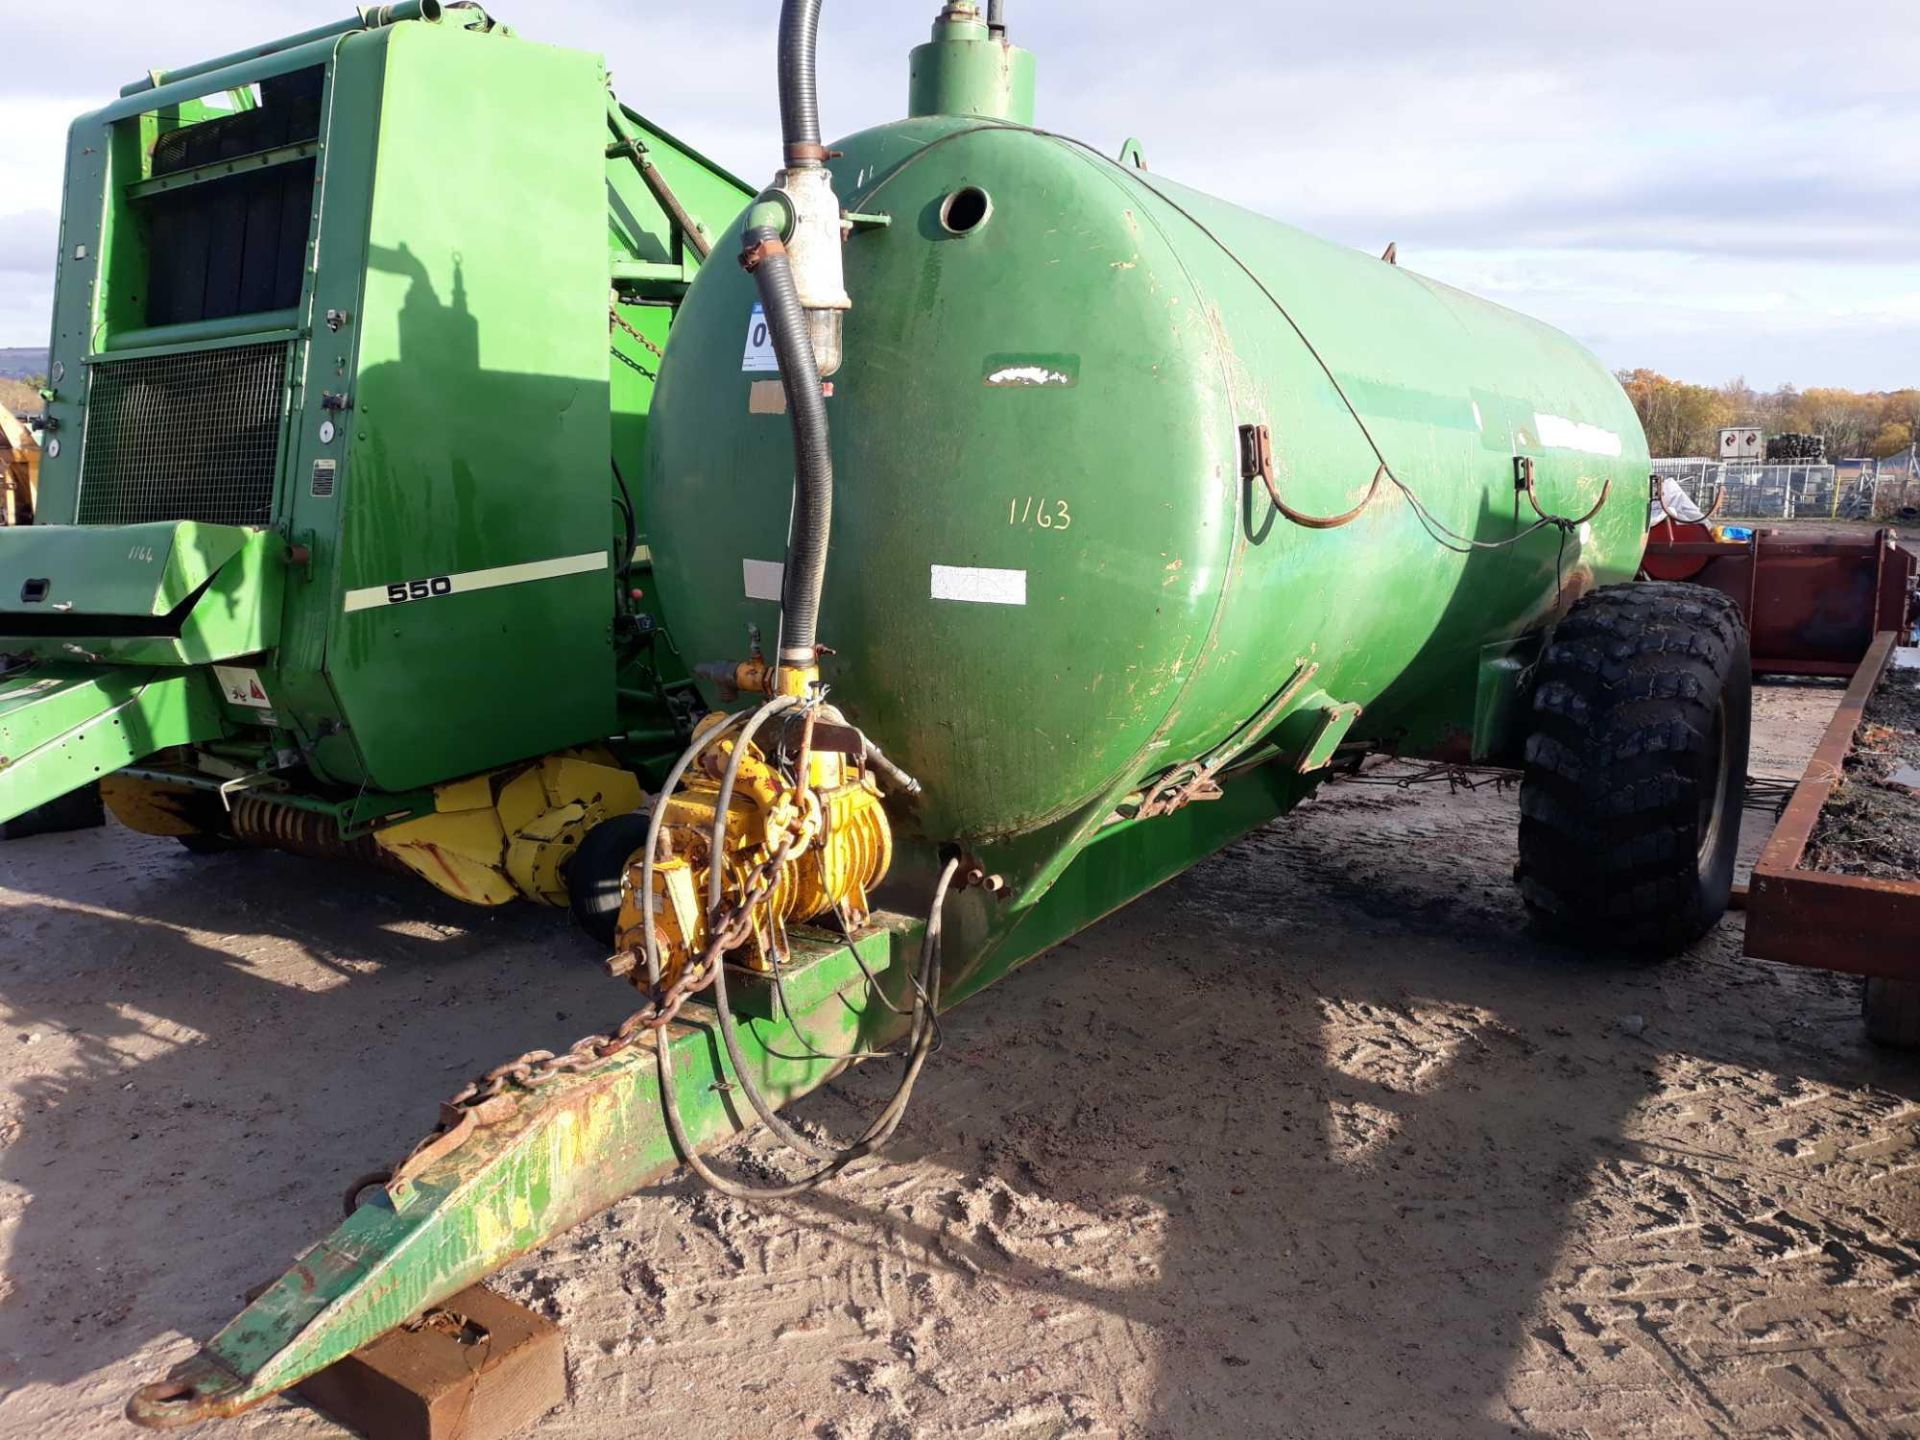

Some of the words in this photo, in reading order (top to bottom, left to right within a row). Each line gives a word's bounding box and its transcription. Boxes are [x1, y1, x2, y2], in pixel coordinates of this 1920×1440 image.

[1009, 496, 1071, 530] 1163
[128, 545, 153, 563] 1164
[387, 576, 451, 603] 550
